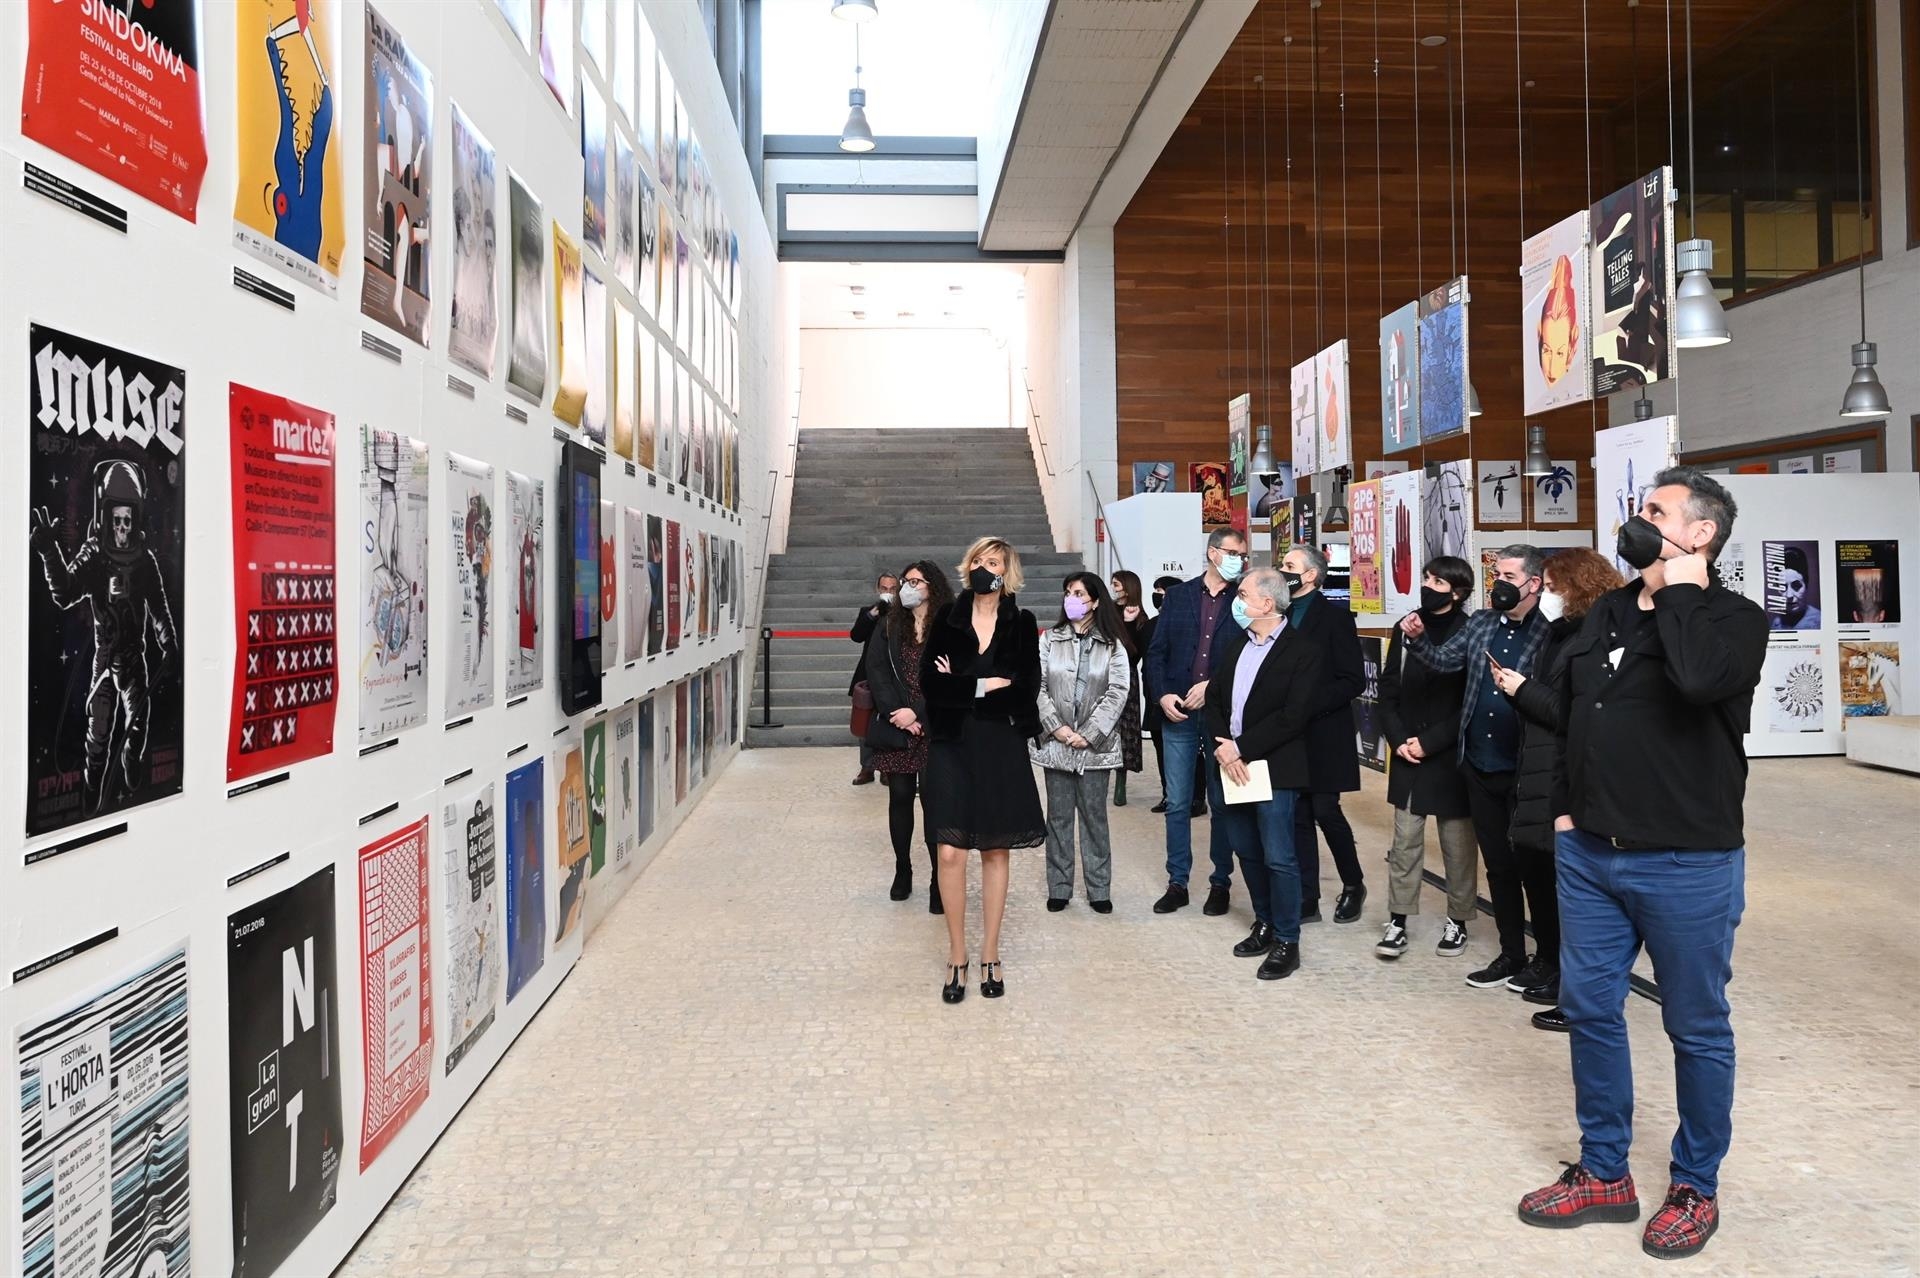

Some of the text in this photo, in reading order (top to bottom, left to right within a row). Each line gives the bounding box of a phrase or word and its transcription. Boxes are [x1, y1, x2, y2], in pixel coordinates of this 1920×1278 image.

[80, 24, 154, 81] FESTIVAL DEL LIBRO
[81, 0, 186, 82] SINDOKMA
[80, 50, 162, 110] DEL 25 AL 28 DE OCTUBRE 2018
[98, 76, 118, 95] Cultural
[169, 121, 174, 129] 2
[1607, 249, 1633, 276] TELLING
[1611, 265, 1630, 286] TALES
[469, 841, 478, 858] de
[470, 860, 477, 874] de
[235, 917, 265, 939] 21.07.2018
[282, 936, 315, 1047] N
[61, 1043, 88, 1068] FESTIVAL
[127, 1053, 153, 1079] 20.05.2018
[263, 1063, 276, 1085] La
[69, 1097, 86, 1117] TURIA
[252, 1088, 276, 1123] gran
[286, 1089, 303, 1192] T
[65, 1194, 76, 1207] PLATA
